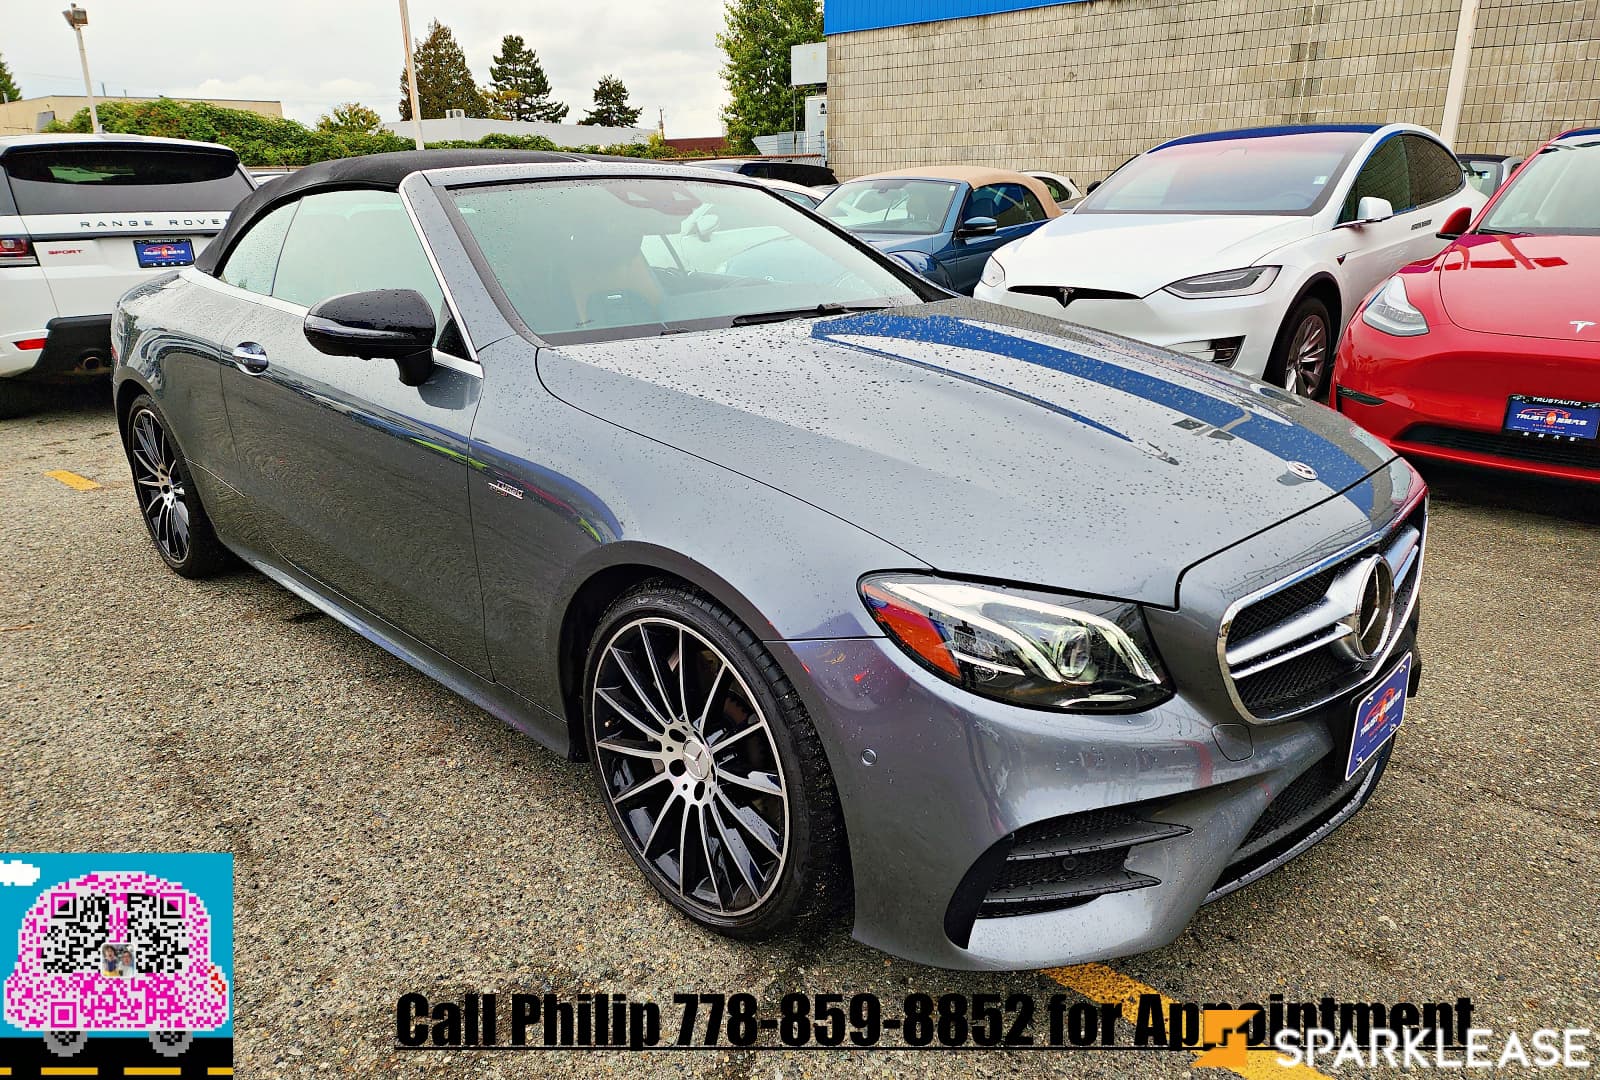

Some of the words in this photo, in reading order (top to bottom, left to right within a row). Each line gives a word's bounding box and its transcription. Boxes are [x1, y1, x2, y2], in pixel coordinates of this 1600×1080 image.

[80, 220, 153, 228] RANGE
[1532, 397, 1581, 406] TRUSTAUTO
[1516, 413, 1545, 421] TRUST
